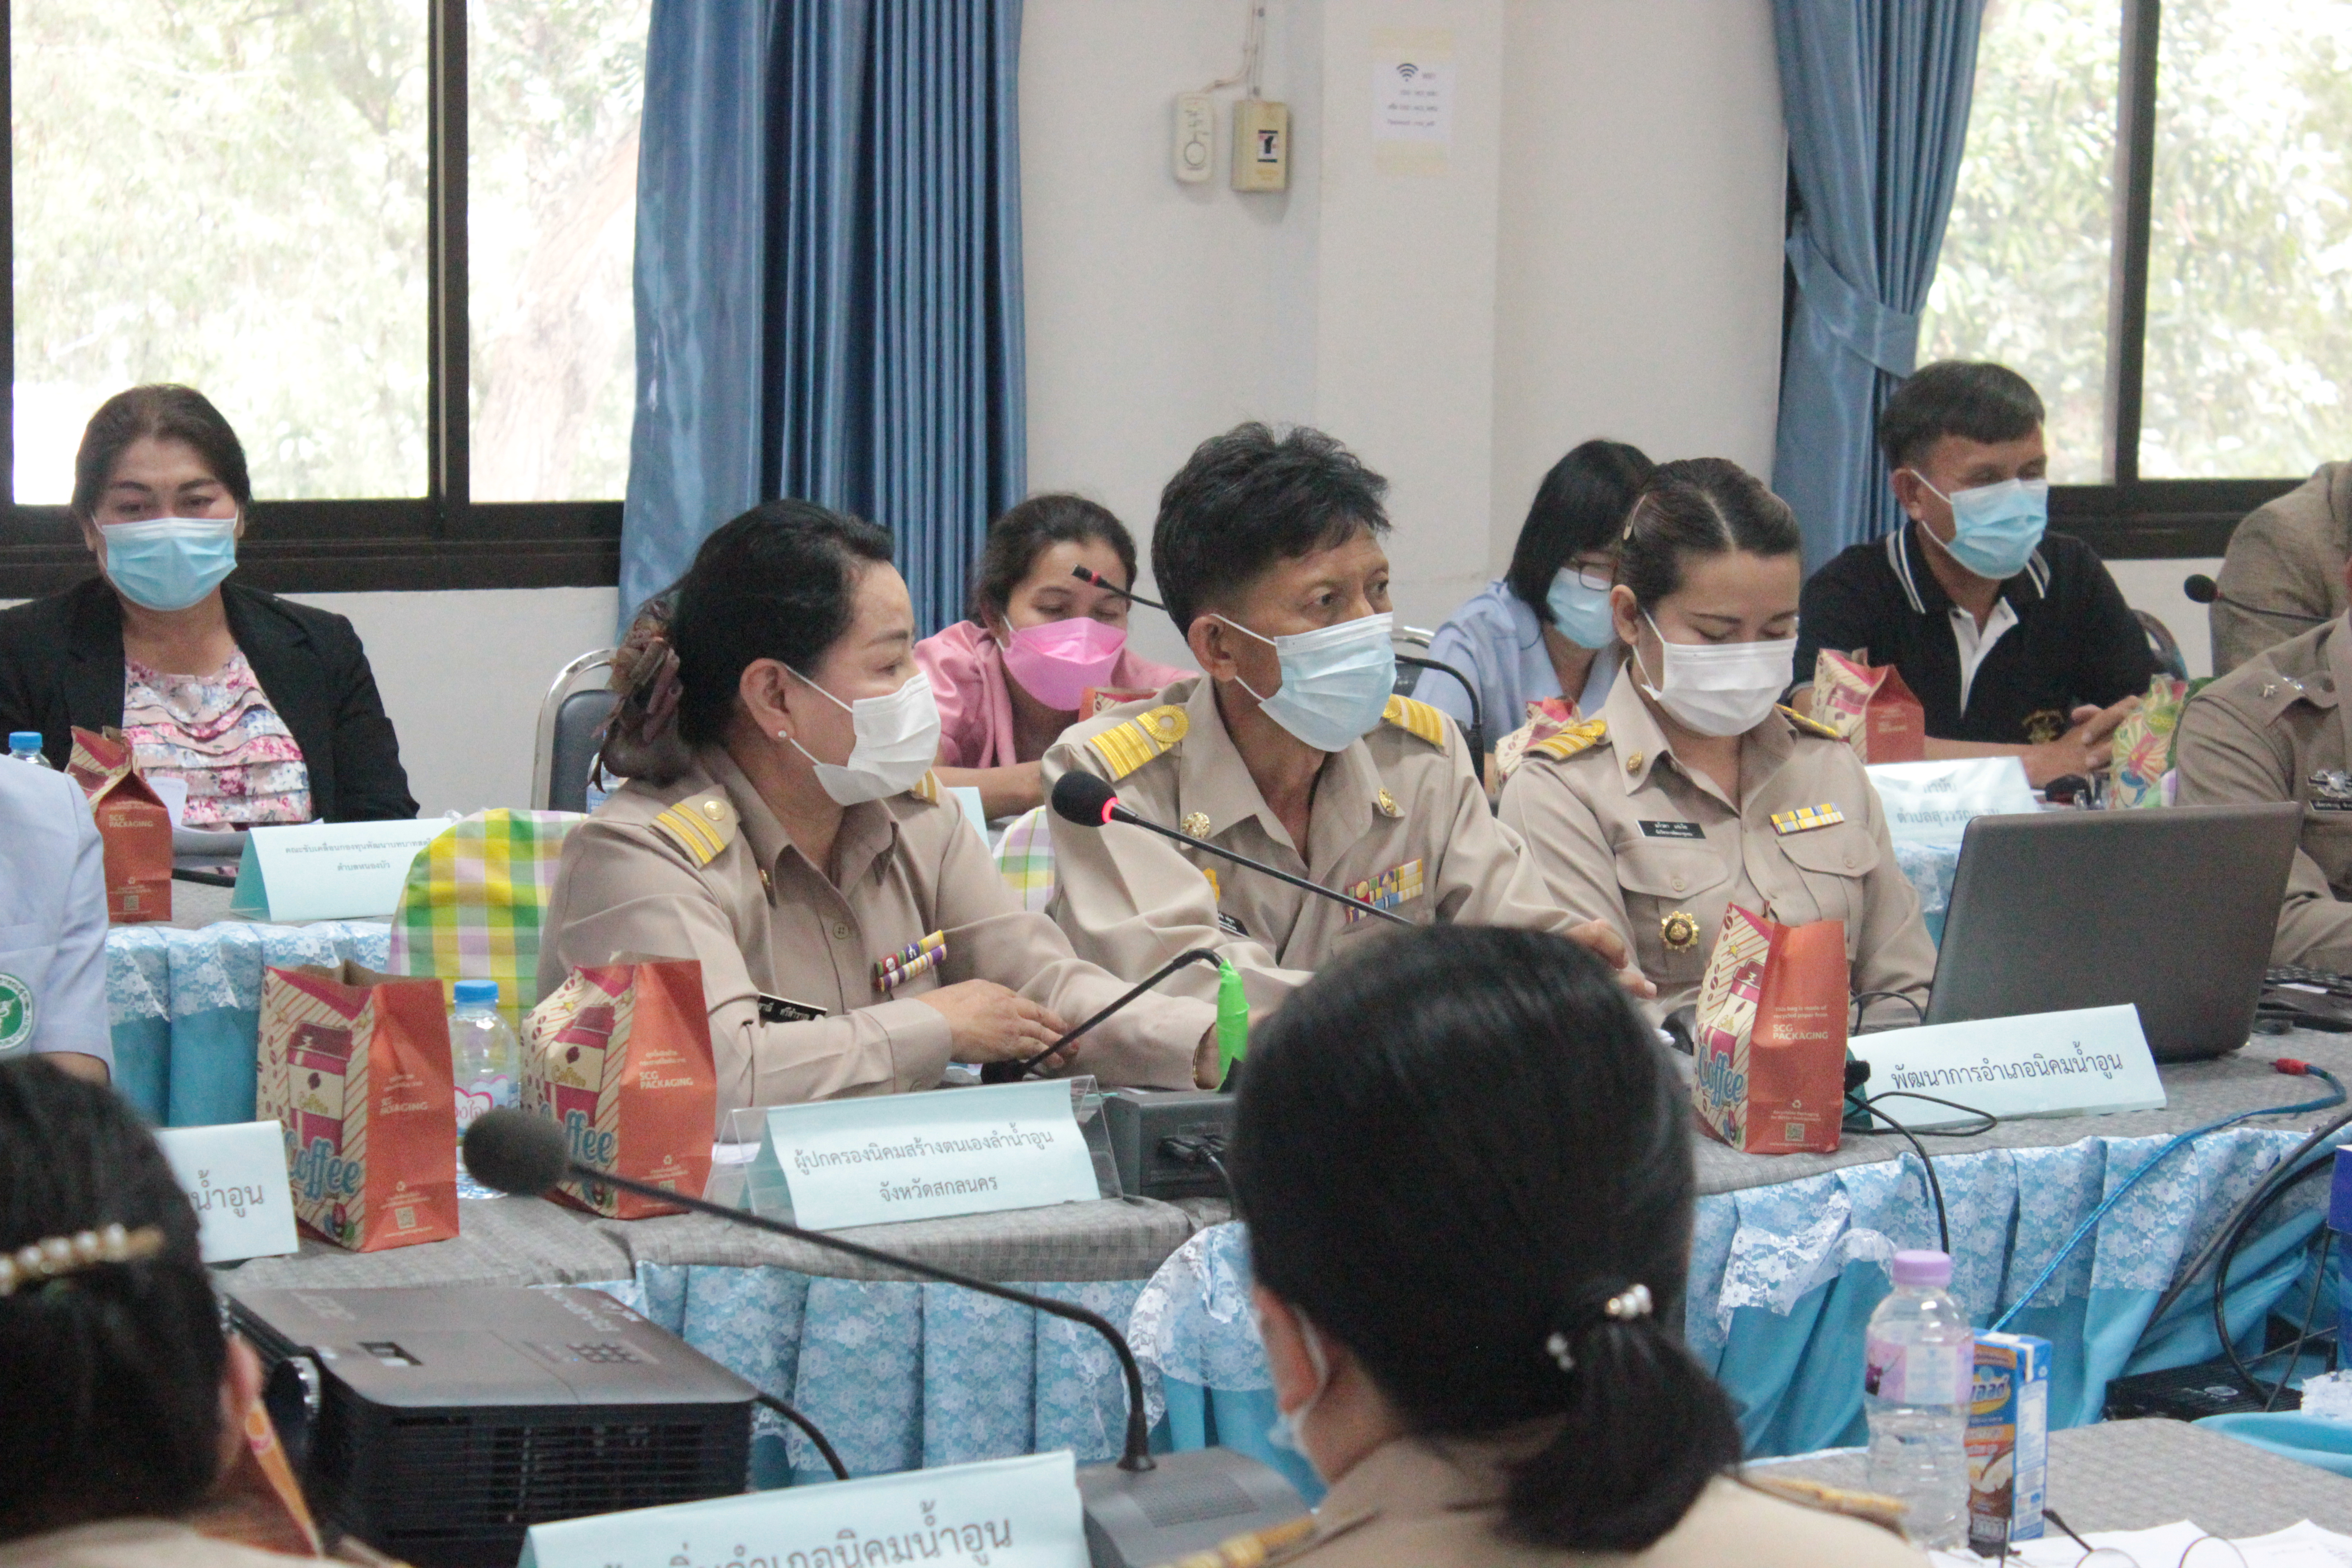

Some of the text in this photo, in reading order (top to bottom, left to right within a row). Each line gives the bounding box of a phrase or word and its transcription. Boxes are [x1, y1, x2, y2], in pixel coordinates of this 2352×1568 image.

[1773, 1024, 1793, 1032] SCG
[640, 1071, 658, 1080] SCG
[1698, 1044, 1744, 1108] Coffee
[1891, 1041, 2123, 1089] พัฒนาการอำเภอนิคมน้ำอูน
[640, 1077, 693, 1089] PACKAGING
[794, 1122, 1054, 1176] ผู้ปกครองนิคมสร้างตนเองลำน้ำอูน
[880, 1176, 998, 1202] จังหวัดสกลนคร
